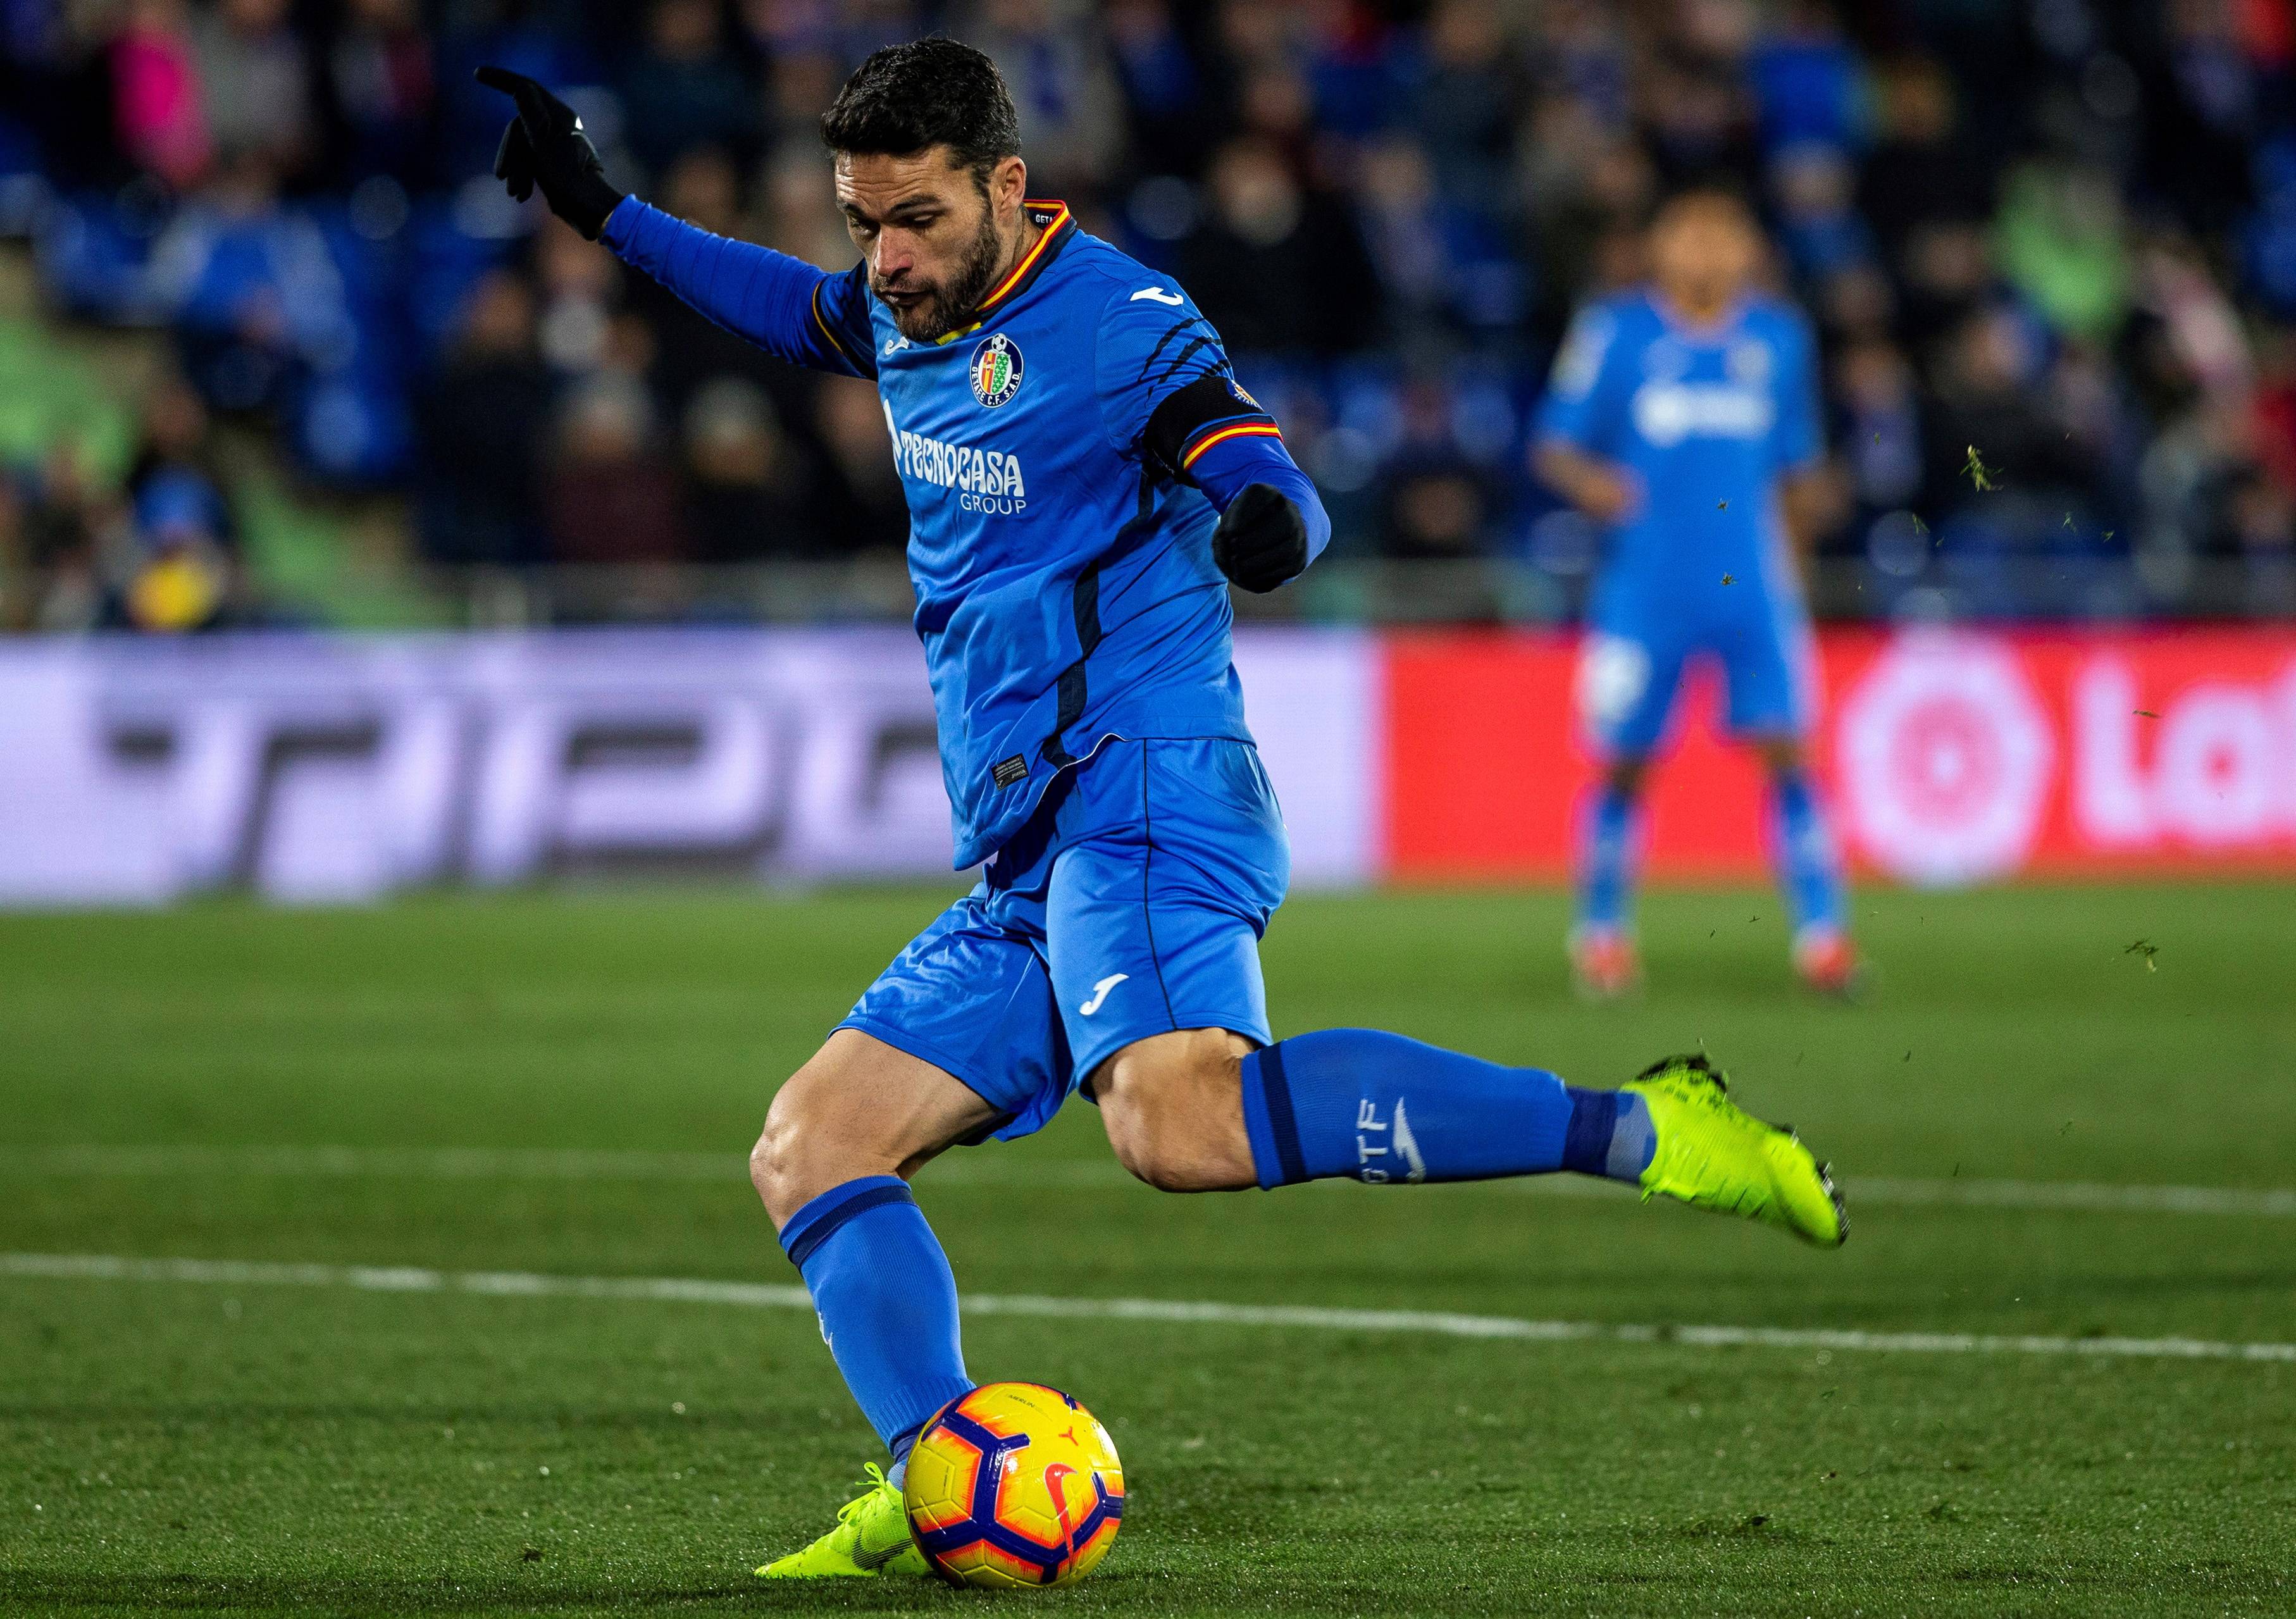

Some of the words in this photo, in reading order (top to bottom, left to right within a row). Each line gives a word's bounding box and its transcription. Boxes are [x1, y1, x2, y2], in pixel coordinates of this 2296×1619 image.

[971, 366, 986, 402] GETAFE
[988, 395, 1002, 406] C.F.
[1004, 373, 1021, 398] S.A.D.
[900, 430, 1025, 497] TECNOCASA
[960, 493, 1026, 515] GROUP
